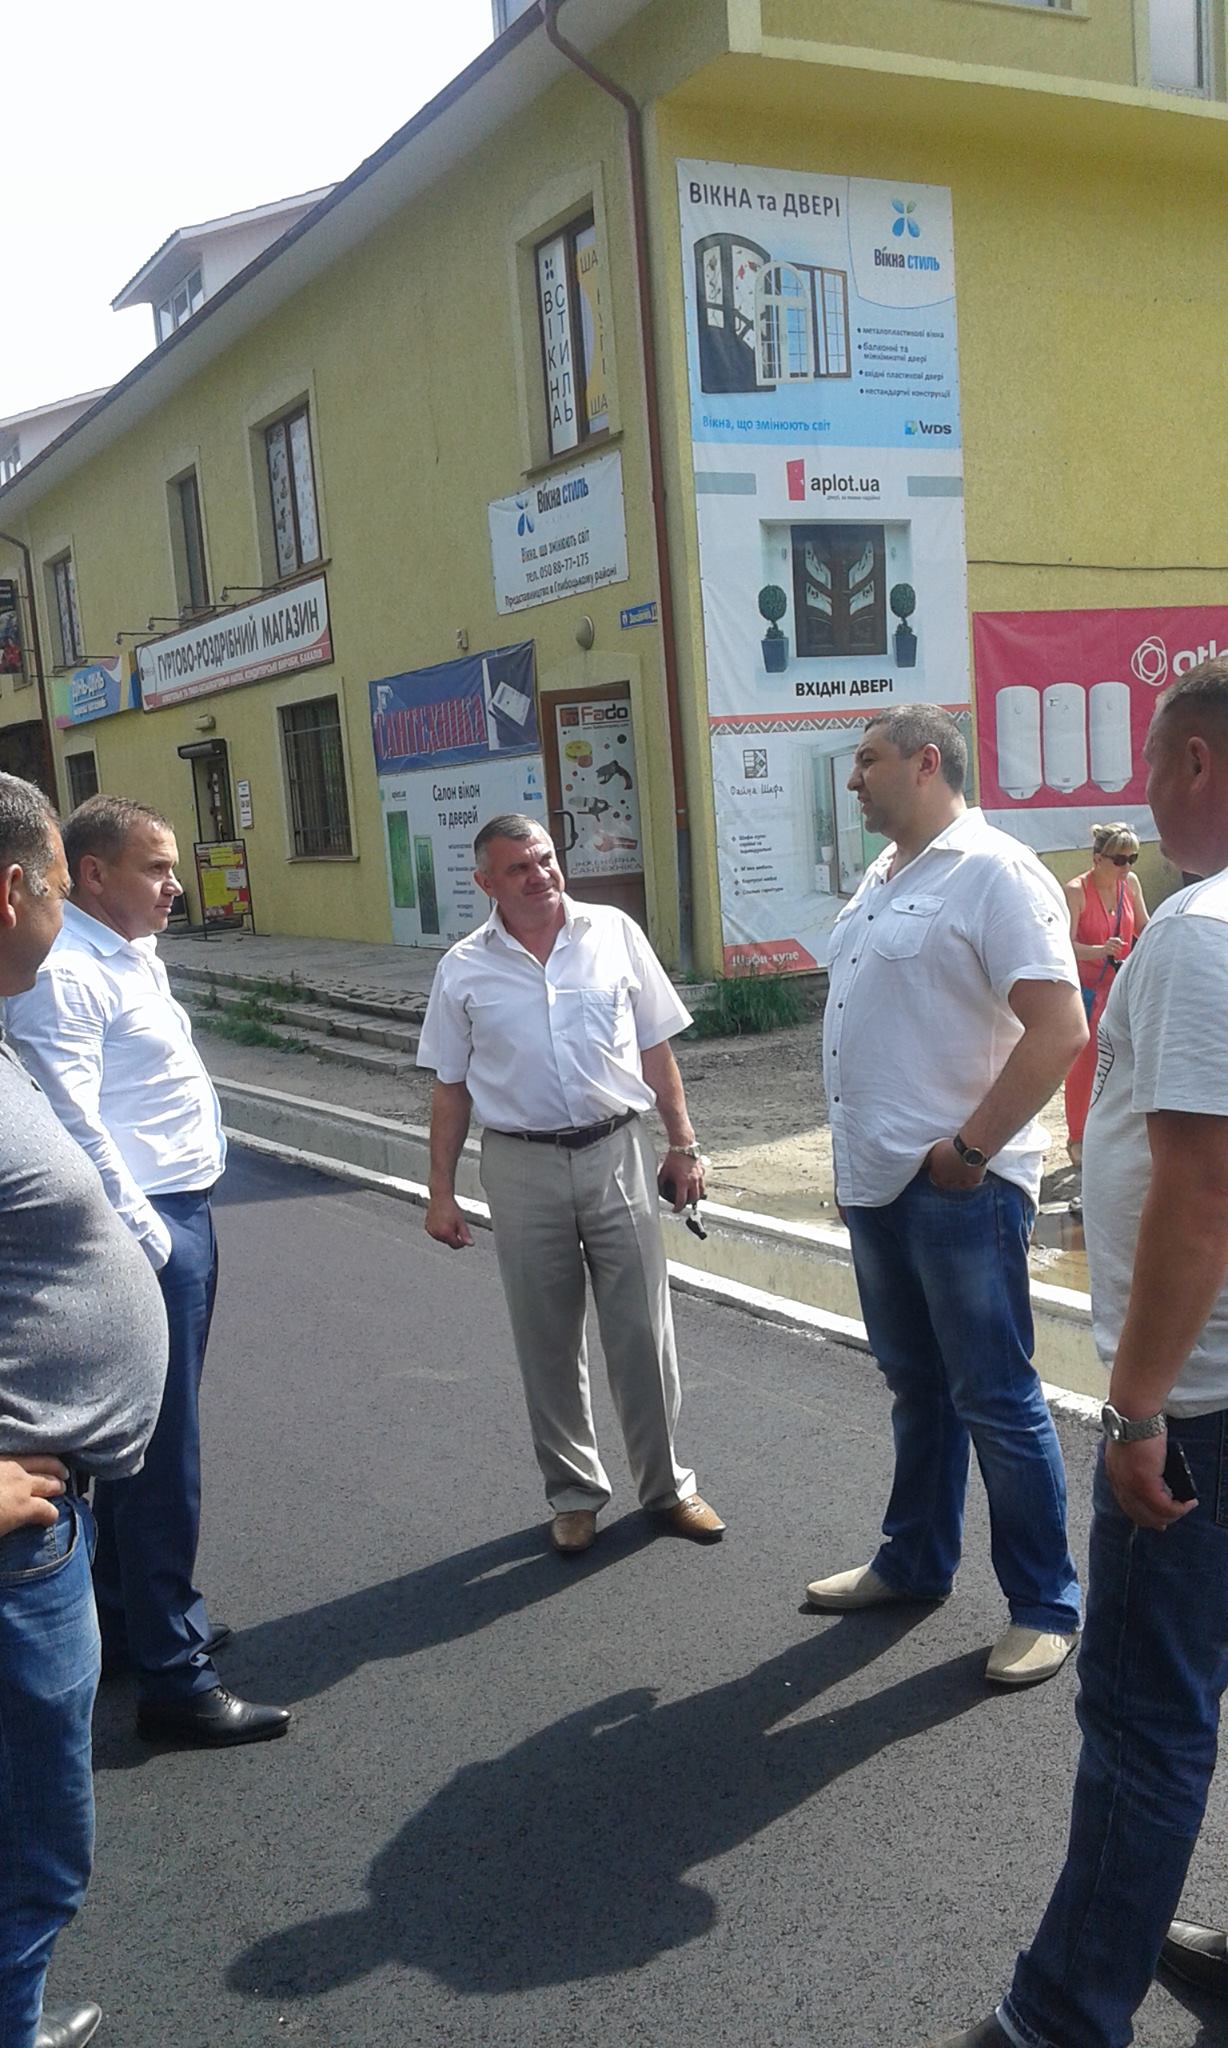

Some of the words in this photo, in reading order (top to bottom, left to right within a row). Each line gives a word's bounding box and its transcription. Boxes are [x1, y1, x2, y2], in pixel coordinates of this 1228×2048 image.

[689, 182, 752, 210] ВІКНА
[757, 193, 777, 211] та
[783, 193, 840, 218] ДВЕРІ
[874, 246, 905, 268] Вікна
[702, 415, 734, 431] Вікна,
[736, 418, 753, 430] що
[755, 419, 809, 431] змінюють
[812, 420, 831, 431] світ
[919, 420, 952, 435] WDS
[810, 473, 880, 495] aplot.ua
[536, 482, 562, 514] Вікна
[157, 613, 260, 682] ГУРТОВО-РОЗДРІБНИЙ
[261, 597, 319, 648] МАГАЗИН
[1172, 639, 1228, 677] atl
[795, 681, 846, 698] ВХІДНІ
[849, 678, 893, 696] ДВЕРІ
[581, 703, 628, 723] Fado
[432, 783, 457, 801] Салон
[458, 780, 480, 799] вікон
[438, 812, 448, 827] та
[448, 805, 479, 829] дверей
